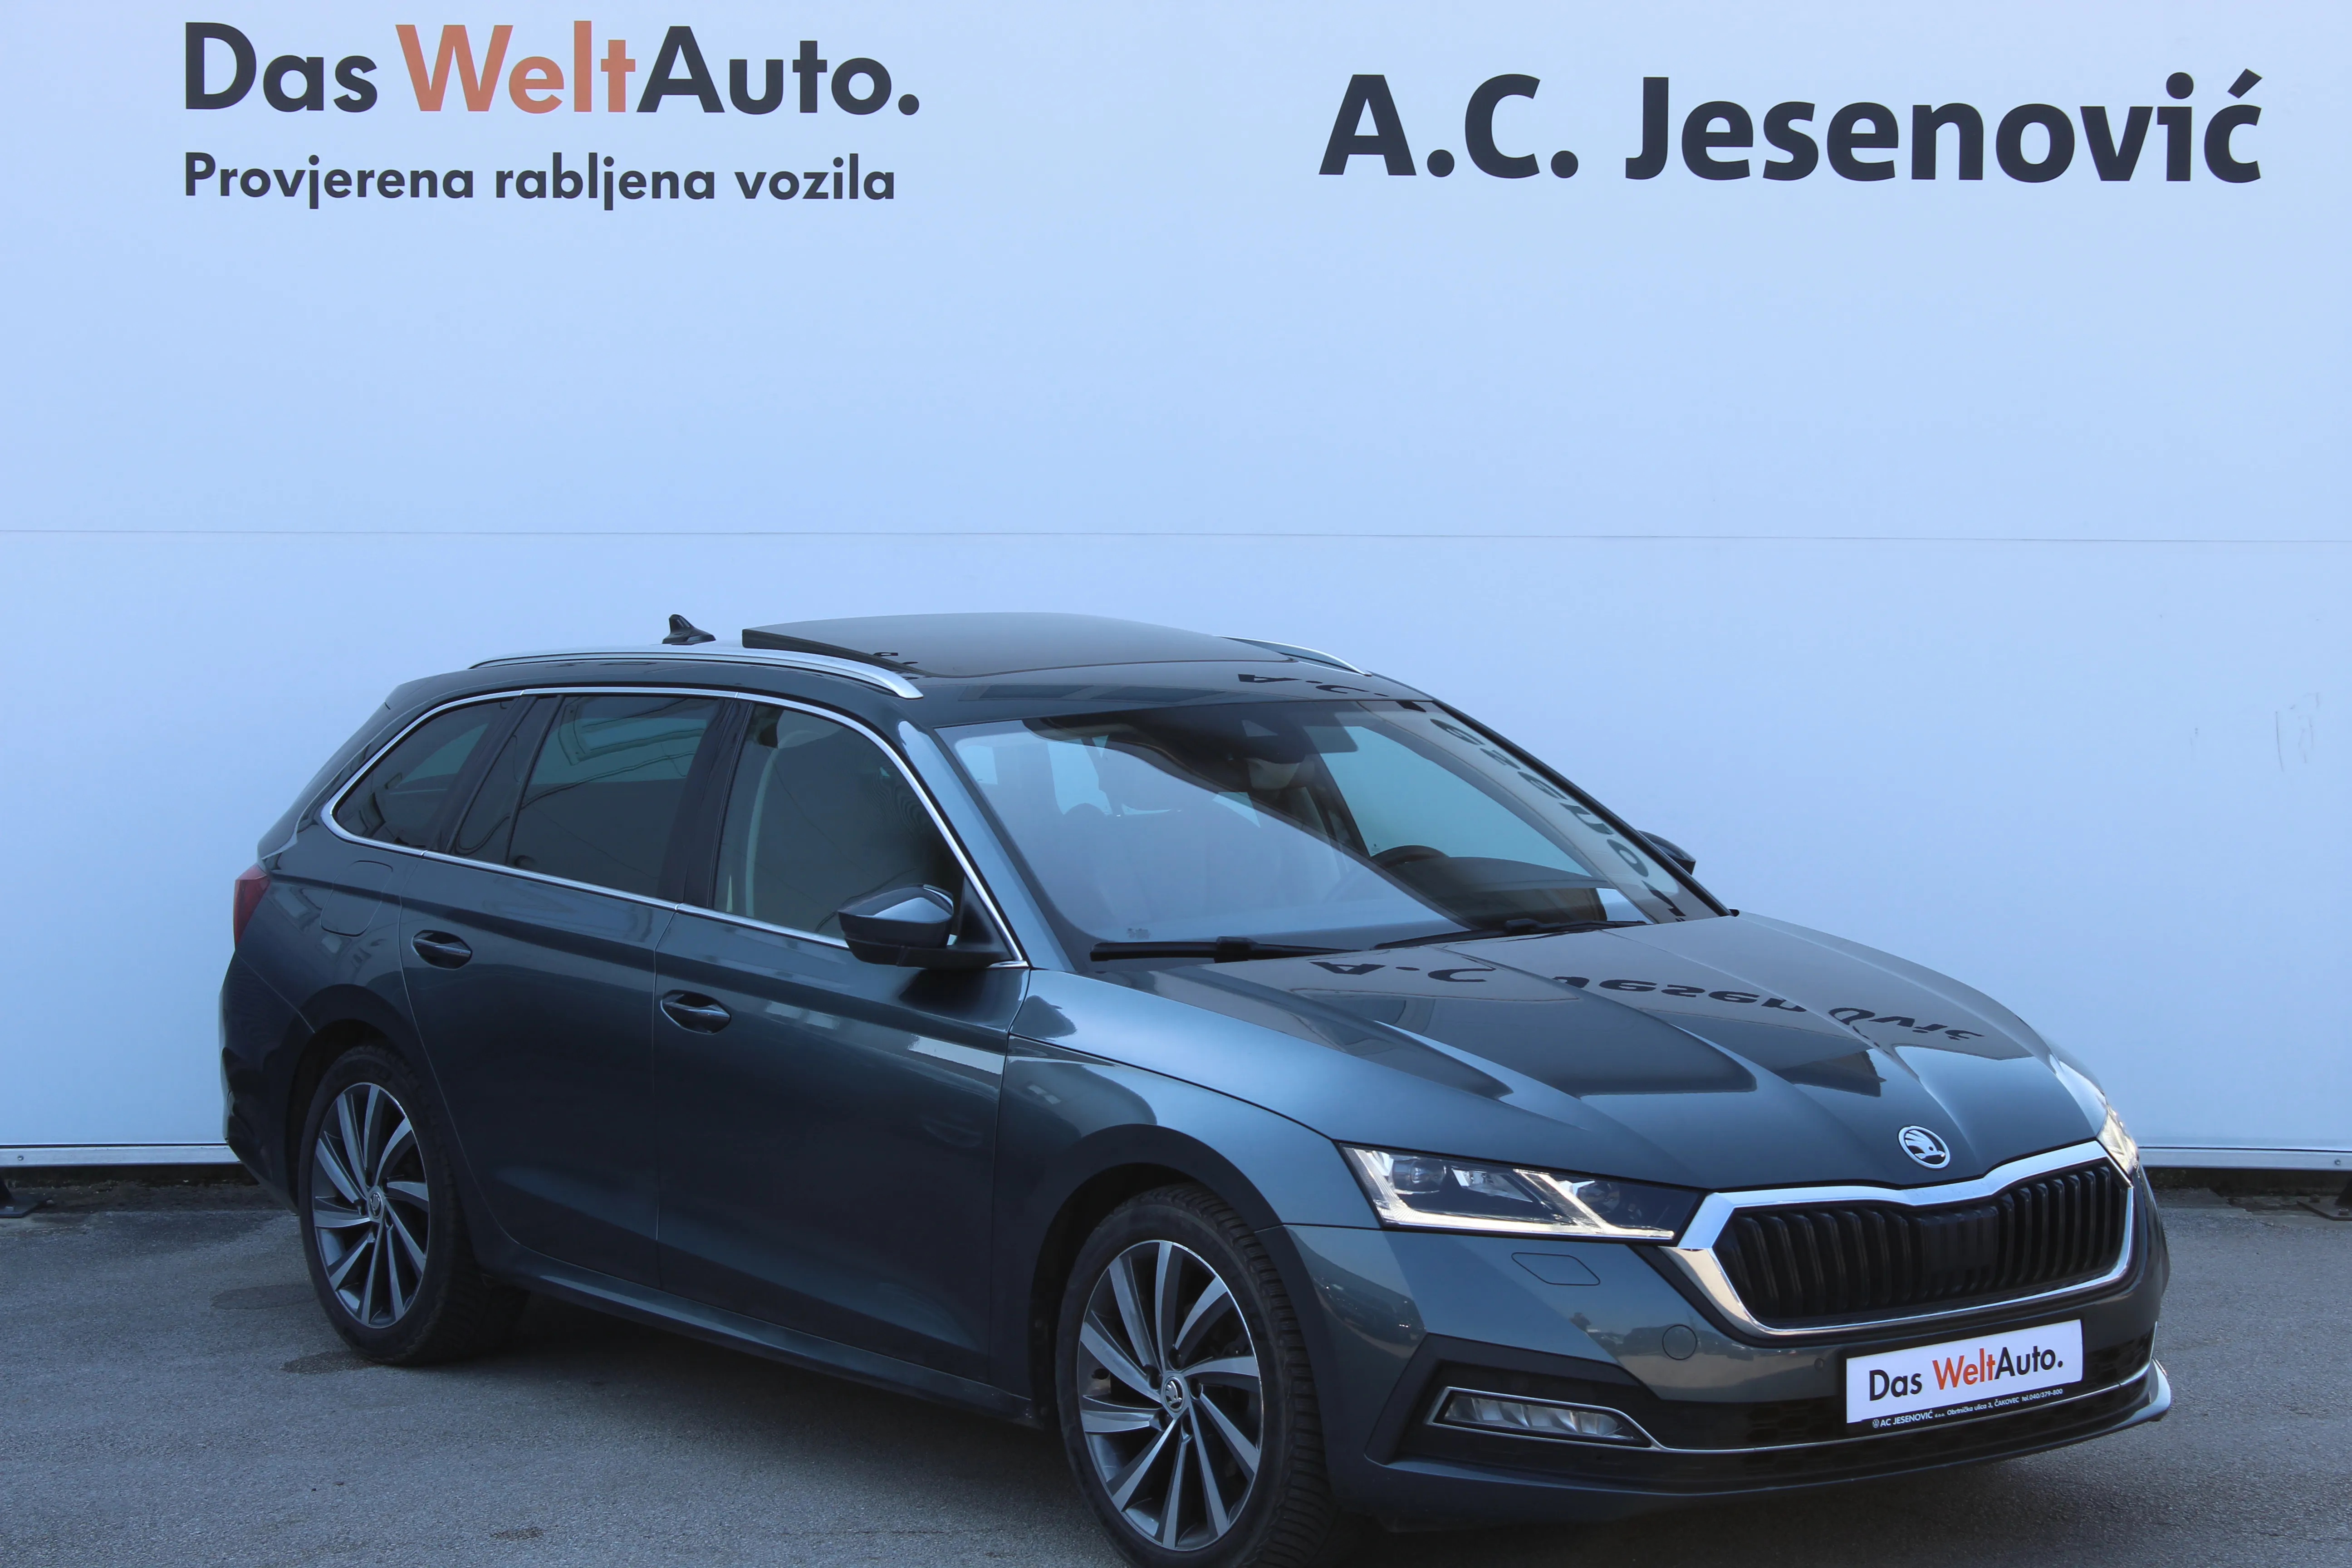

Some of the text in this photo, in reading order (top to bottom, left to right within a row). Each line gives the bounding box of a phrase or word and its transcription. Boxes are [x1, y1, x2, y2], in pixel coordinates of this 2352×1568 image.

[185, 20, 920, 116] Das WeltAuto.
[1318, 68, 2263, 183] A.C. Jesenović
[185, 152, 894, 211] Provjerena rabljena vozila
[1869, 1346, 2063, 1401] Das WeltAuto.
[1880, 1418, 1891, 1427] AC
[1893, 1409, 1933, 1425] JESENOVIĆ
[1947, 1405, 1973, 1416] Obrtnička
[1994, 1396, 2019, 1407] ČAKOVEC
